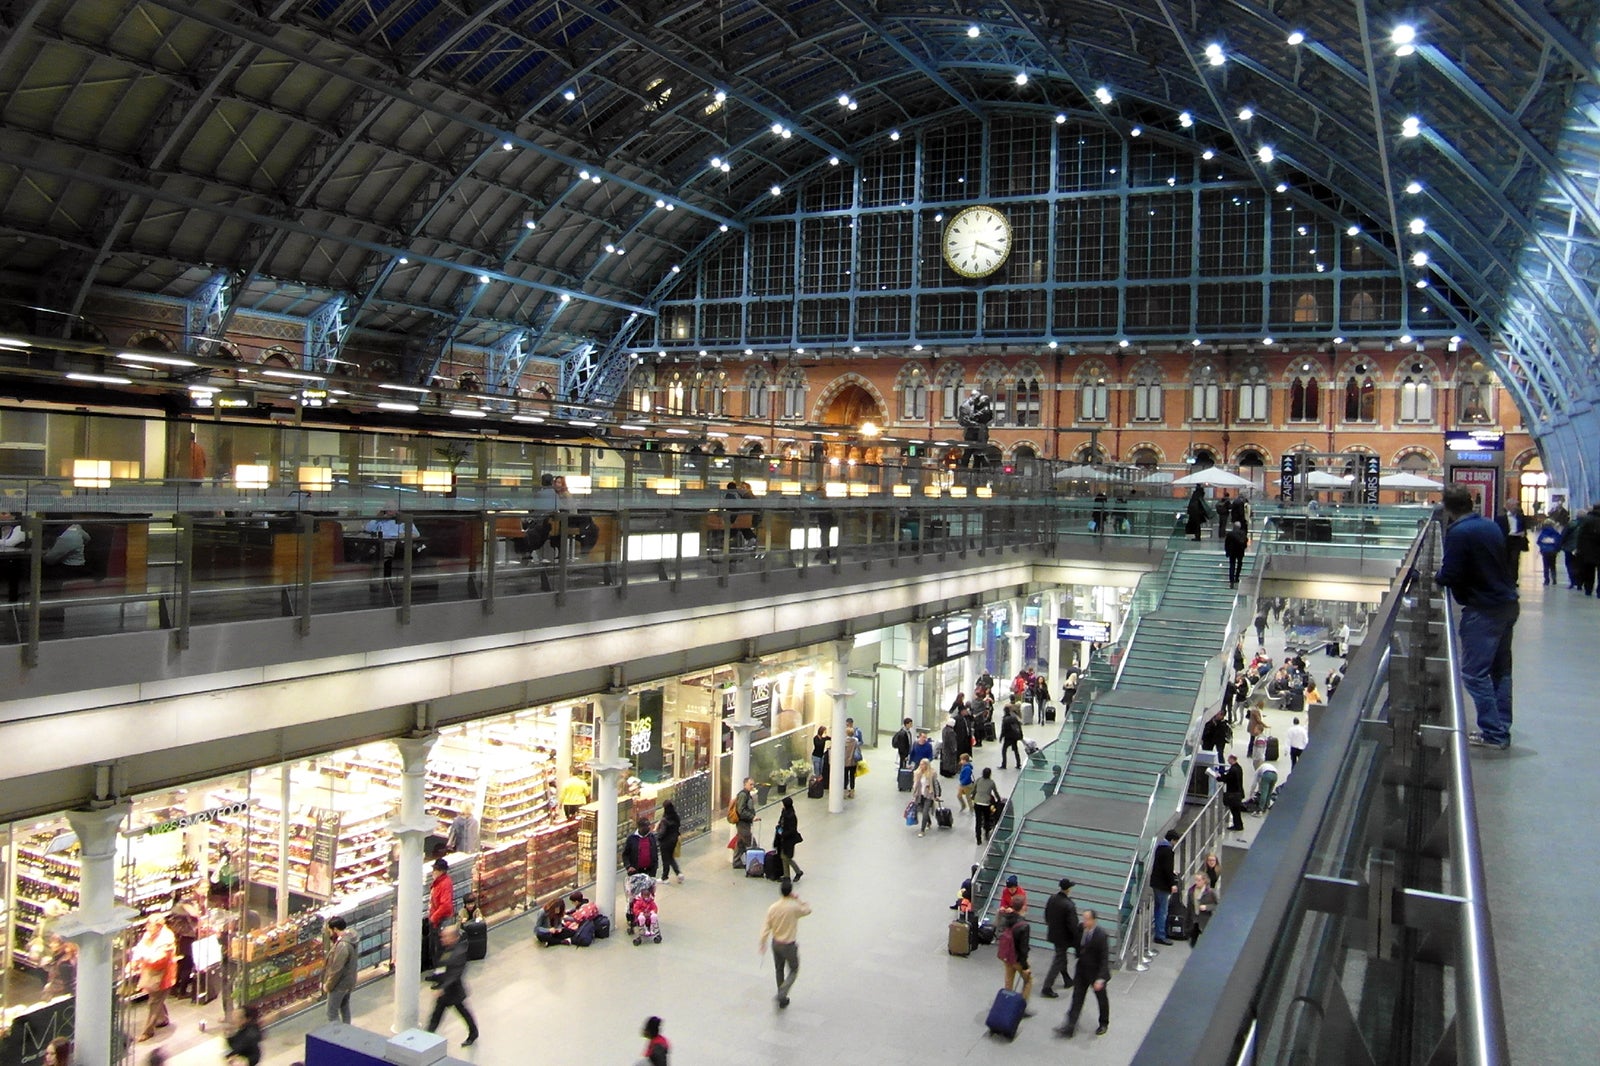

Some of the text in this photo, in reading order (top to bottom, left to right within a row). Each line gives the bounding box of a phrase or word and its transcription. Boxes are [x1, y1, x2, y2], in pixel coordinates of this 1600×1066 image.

[1283, 474, 1293, 502] TAIRS
[630, 716, 652, 735] M&S
[630, 741, 651, 756] FOOD
[151, 802, 248, 835] M&S SIMPLY FOOD
[21, 1005, 76, 1058] M&
